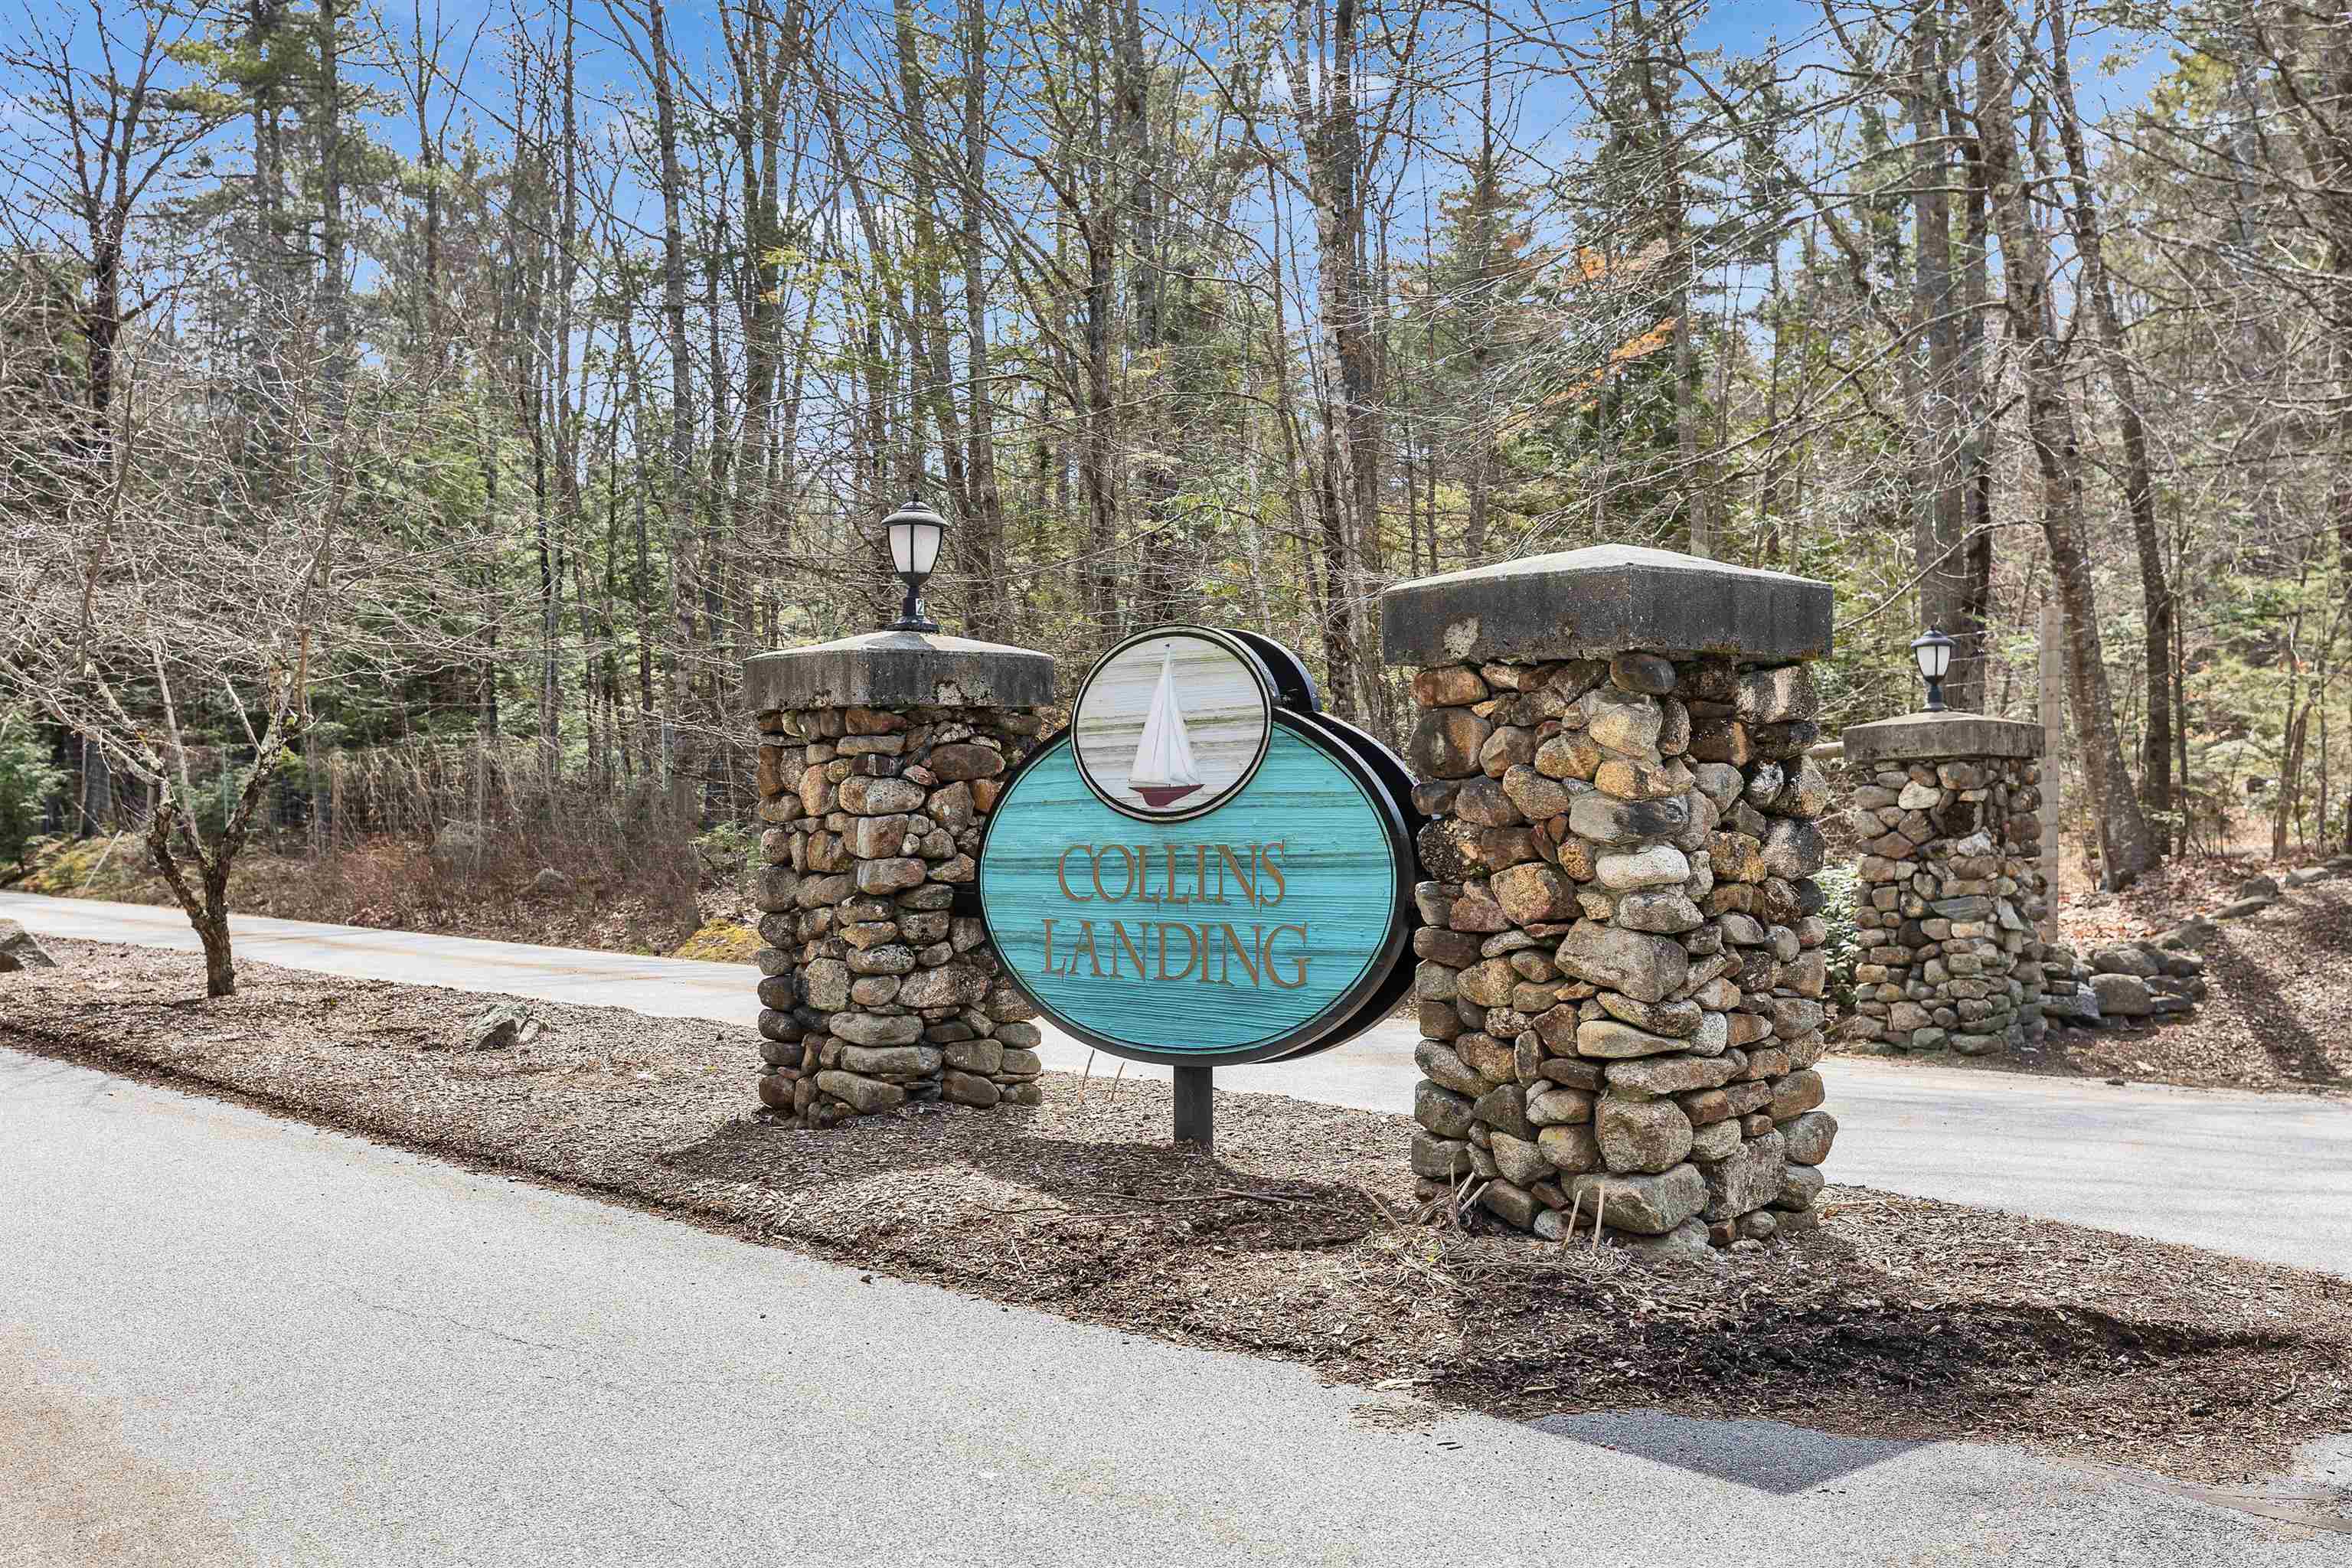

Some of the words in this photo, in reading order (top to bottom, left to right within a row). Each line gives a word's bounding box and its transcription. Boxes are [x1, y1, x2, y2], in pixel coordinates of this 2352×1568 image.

[917, 599, 923, 614] 2
[1057, 841, 1286, 911] COLLINS
[1041, 919, 1311, 989] LANDING
